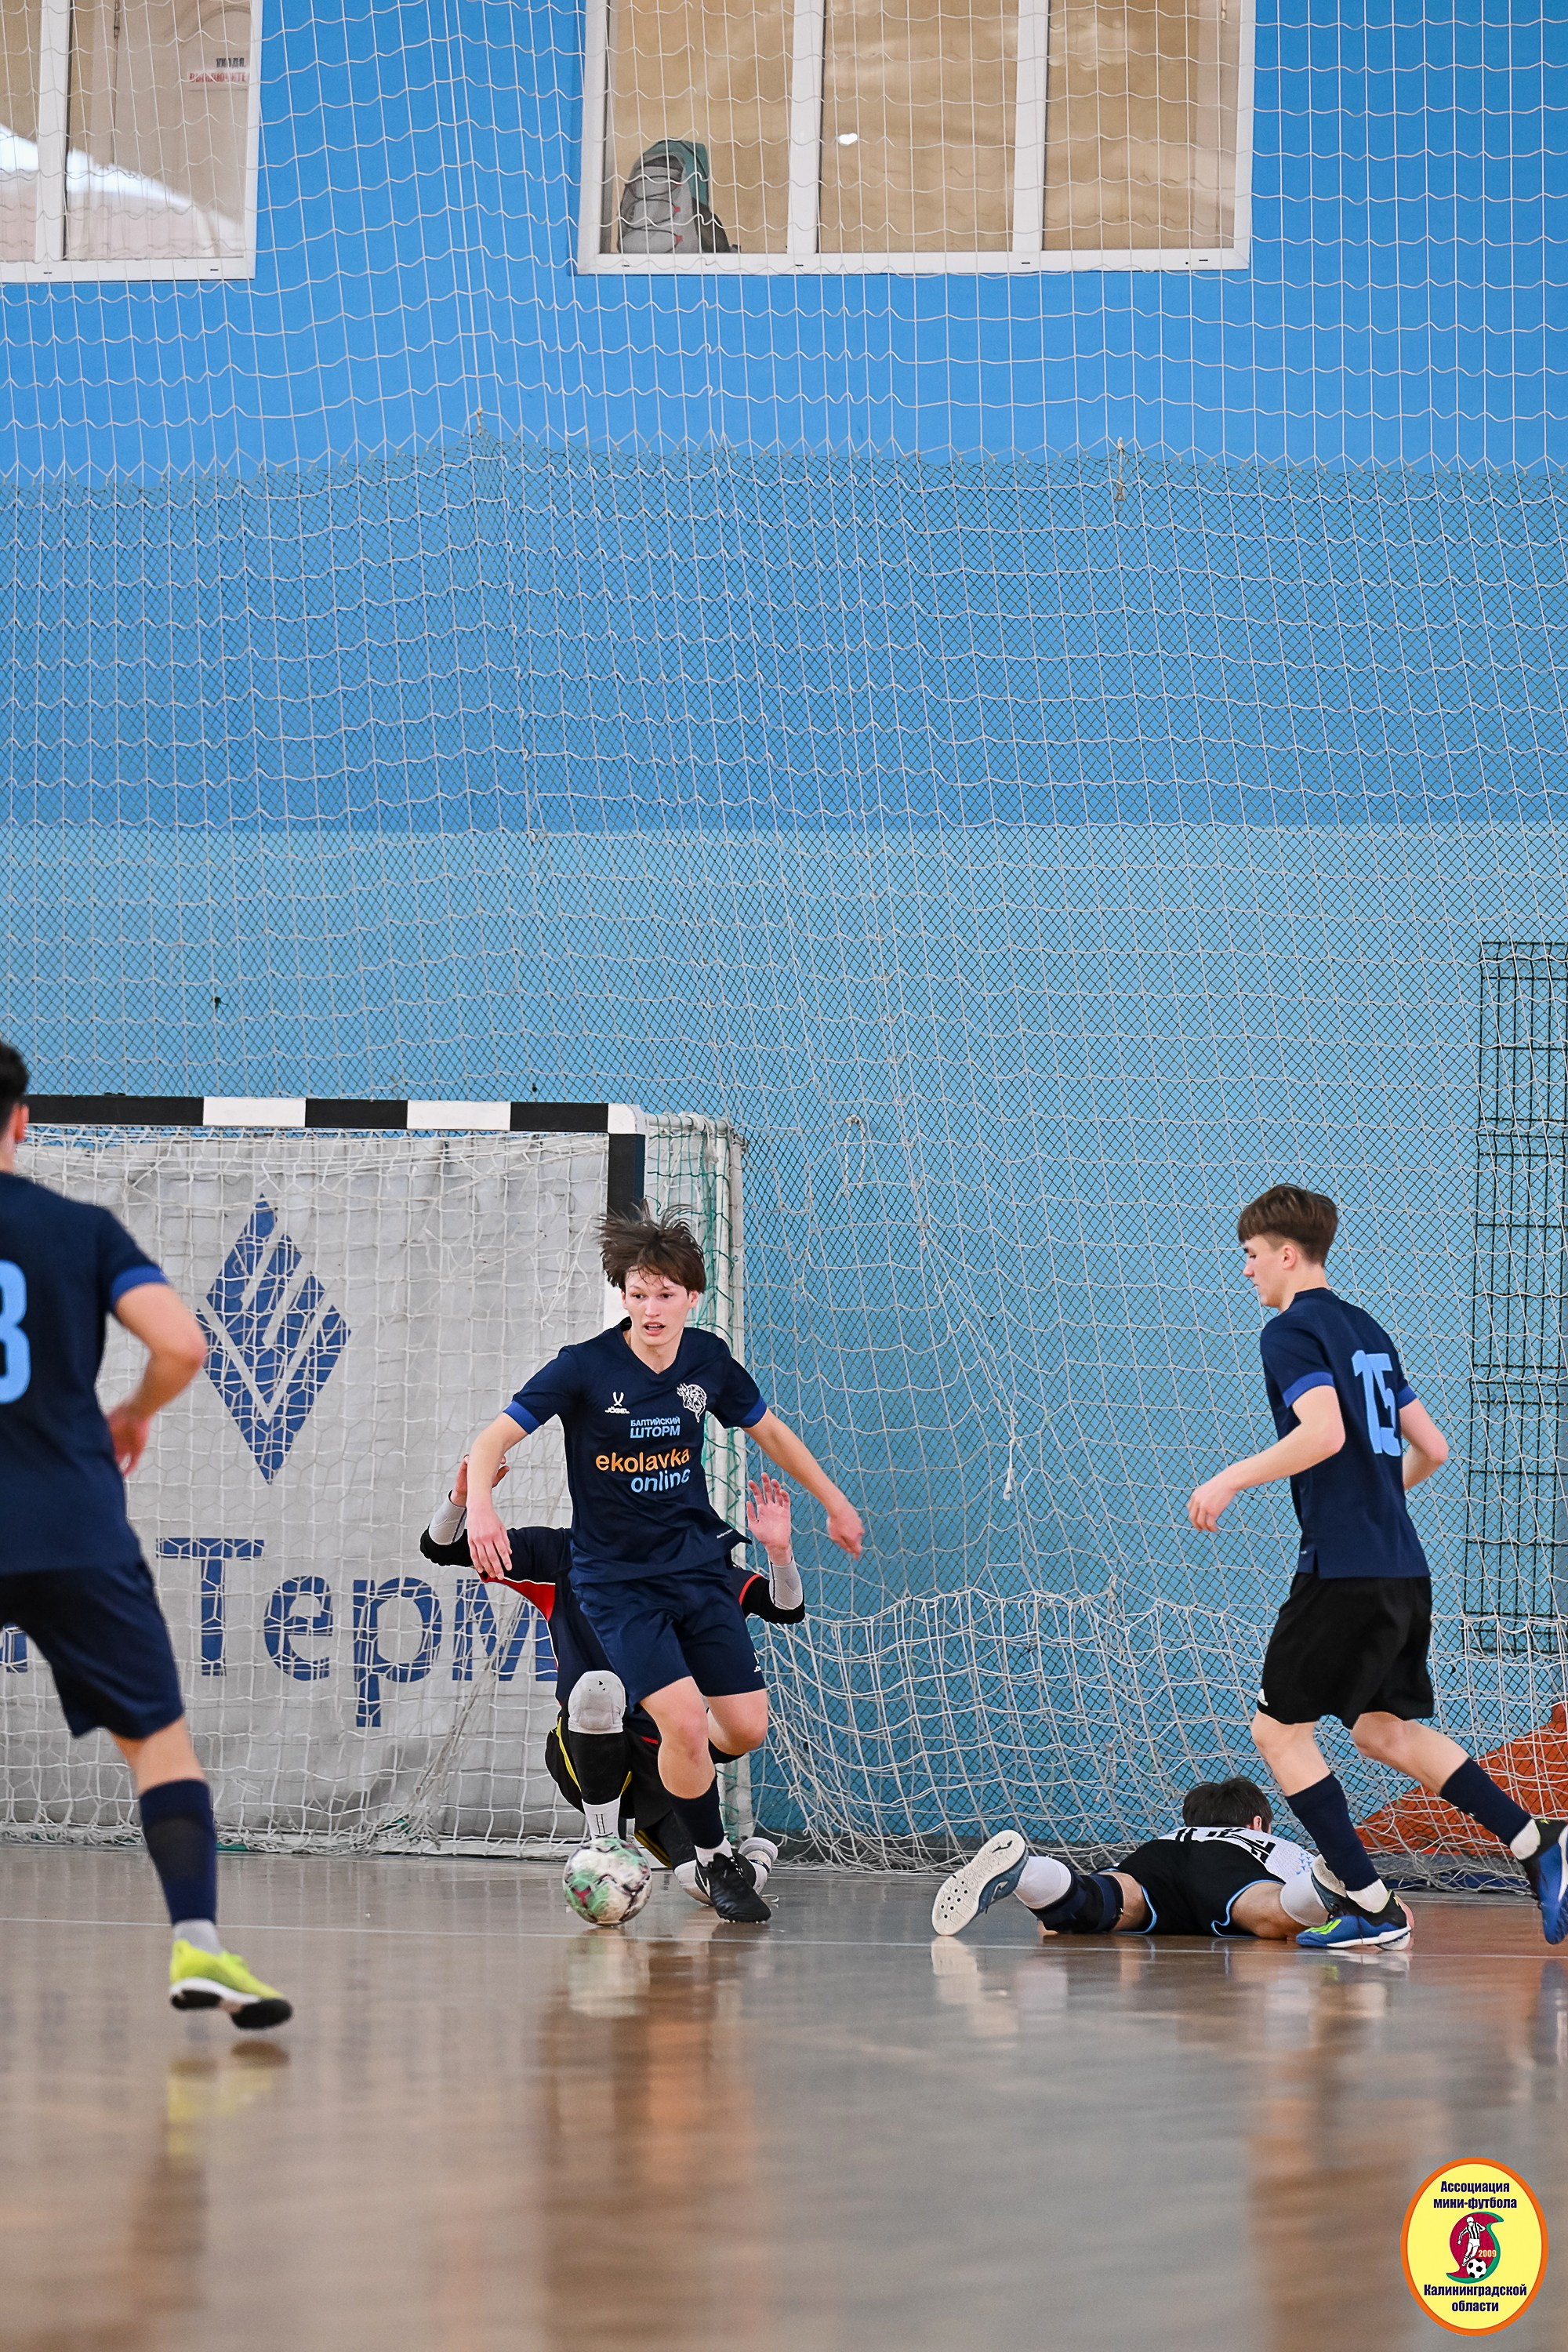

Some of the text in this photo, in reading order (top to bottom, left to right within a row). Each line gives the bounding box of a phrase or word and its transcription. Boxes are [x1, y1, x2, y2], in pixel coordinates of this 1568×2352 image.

[630, 1416, 681, 1427] БАЛТИЙСКИЙ
[630, 1425, 681, 1439] ШТОРМ
[595, 1448, 691, 1473] ekolavka
[630, 1468, 691, 1494] online
